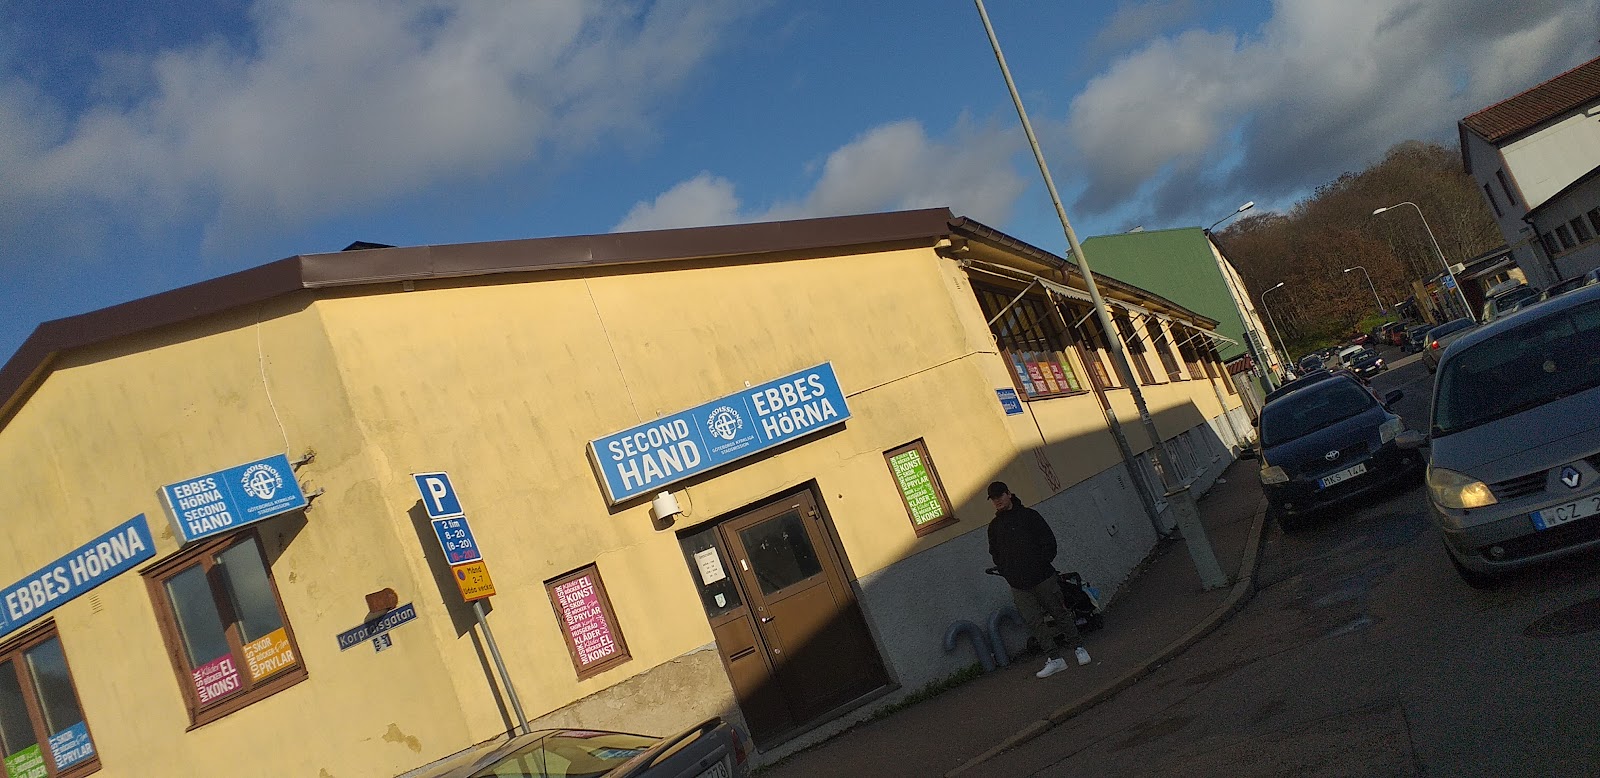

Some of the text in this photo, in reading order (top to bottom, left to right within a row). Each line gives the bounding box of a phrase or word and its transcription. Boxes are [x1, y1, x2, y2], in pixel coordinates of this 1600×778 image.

[752, 373, 826, 417] EBBES
[762, 398, 838, 440] HÖRNA
[608, 419, 690, 461] SECOND
[908, 450, 919, 459] EL
[617, 440, 701, 491] HAND
[900, 458, 922, 472] KONST
[907, 476, 929, 489] PRYLAR
[1323, 465, 1364, 486] MKS 144
[174, 478, 217, 499] EBBES
[426, 478, 447, 512] P
[179, 490, 223, 511] HÖRNA
[909, 495, 930, 507] KLÄDER
[930, 500, 941, 509] EL
[184, 502, 227, 521] SECOND
[921, 508, 944, 522] KONST
[189, 512, 232, 536] HAND
[442, 520, 460, 530] 2 tim
[445, 530, 465, 540] 8-20
[447, 539, 472, 551] (8-20)
[6, 527, 145, 621] EBBES HÖRNA
[579, 577, 592, 588] EL
[567, 586, 594, 604] KONST
[569, 600, 585, 610] SKOR
[574, 607, 601, 622] PRYLAR
[253, 638, 272, 653] SKOR
[574, 629, 601, 645] KLÄDER
[600, 634, 613, 646] EL
[577, 644, 589, 665] MUSIK
[588, 644, 616, 662] KONST
[220, 659, 237, 677] EL
[244, 646, 261, 679] KONST
[260, 651, 294, 674] PRYLAR
[193, 671, 209, 703] MUSIK
[206, 674, 240, 699] KONST
[63, 743, 93, 762] PRYLAR
